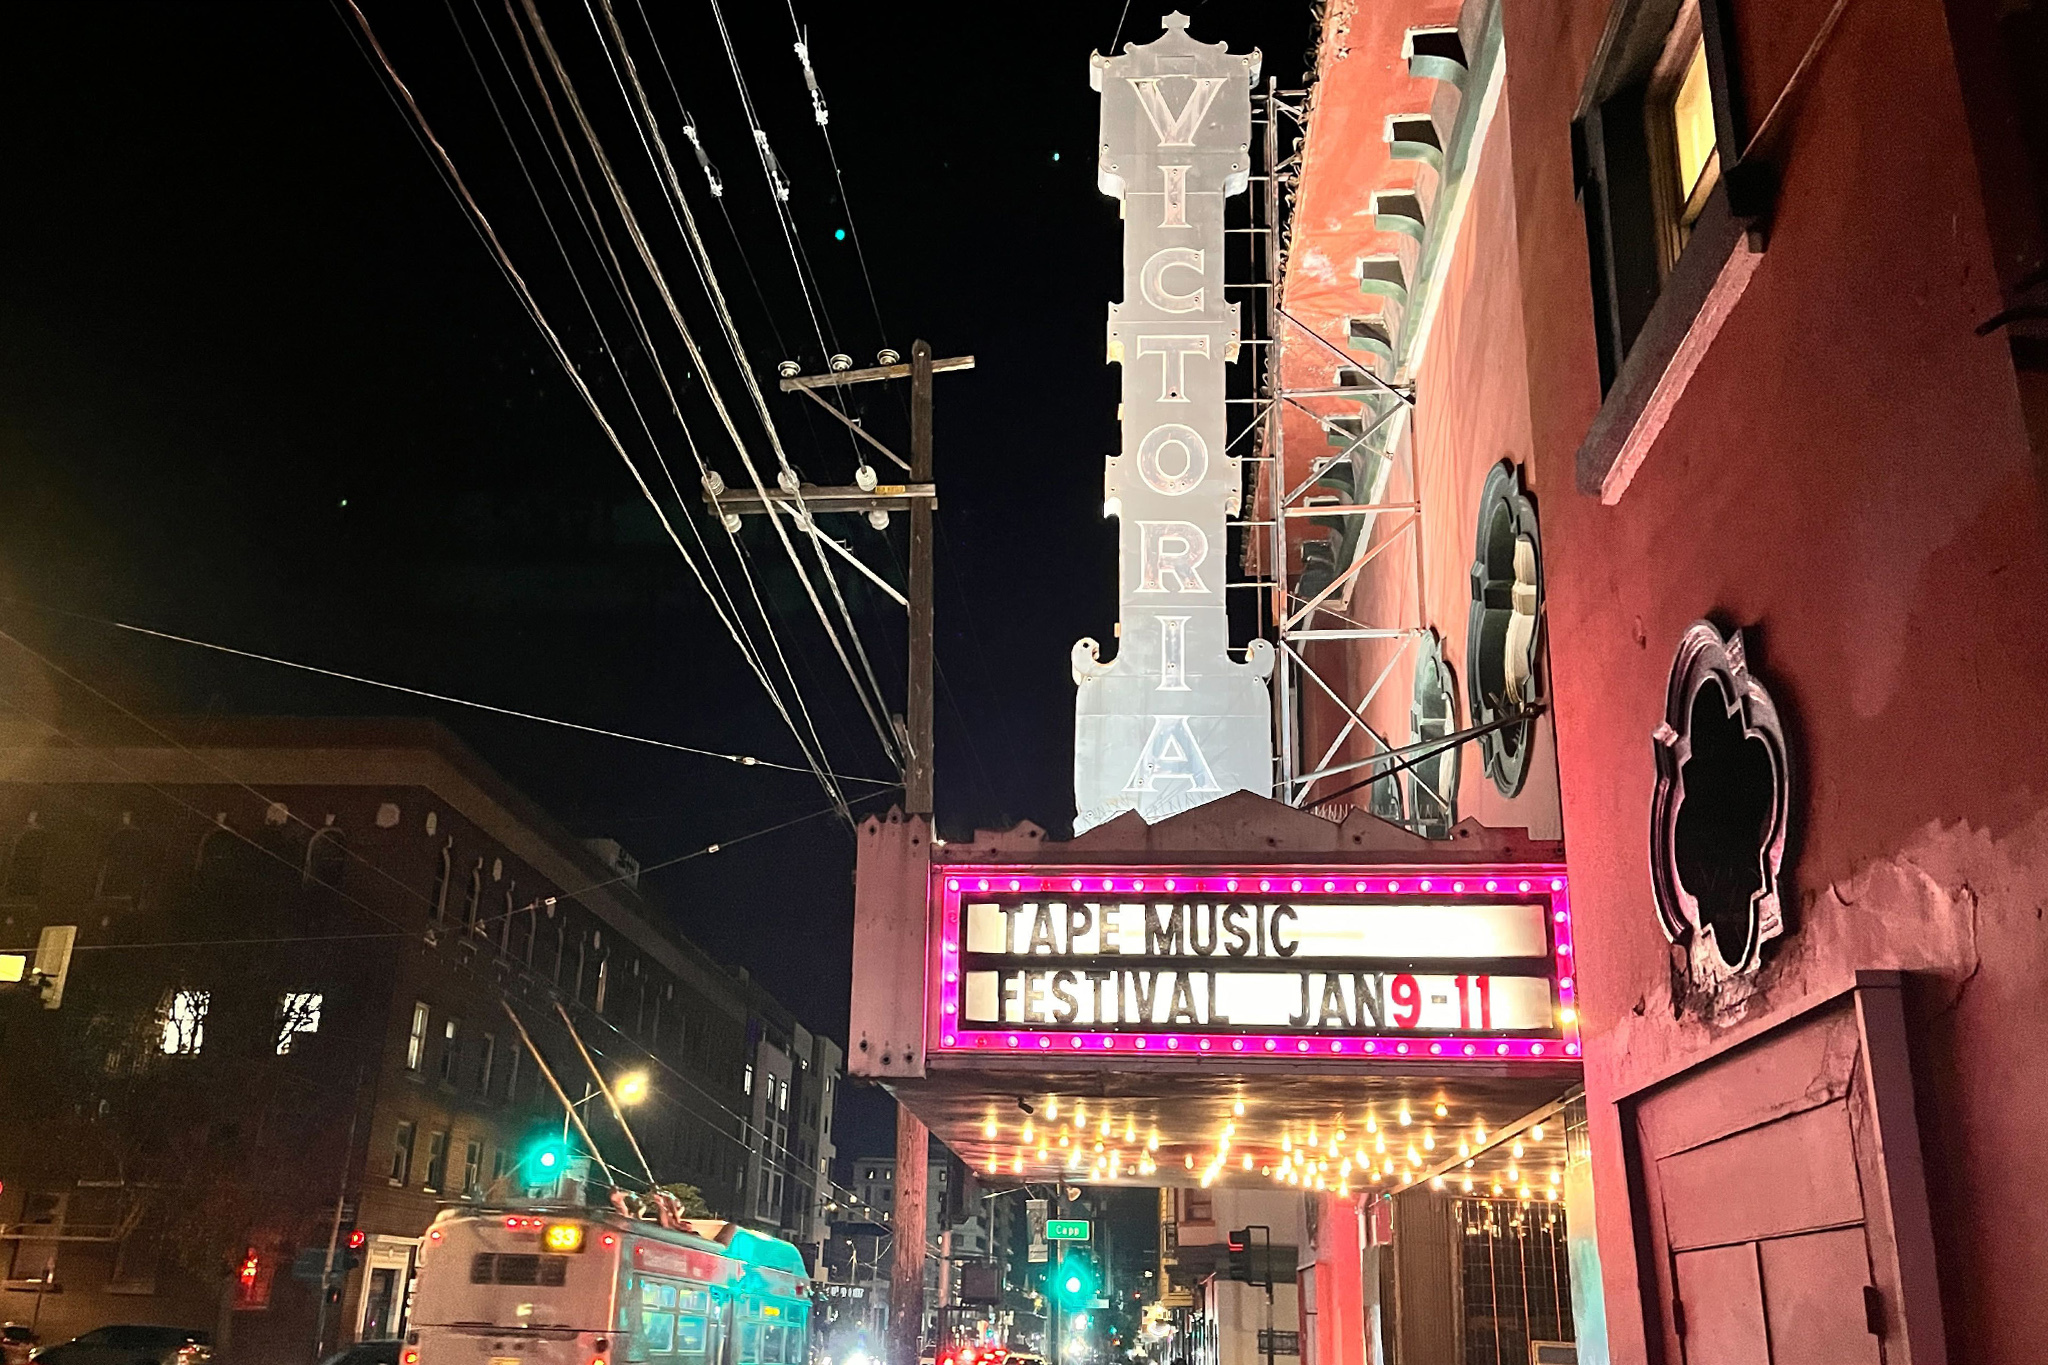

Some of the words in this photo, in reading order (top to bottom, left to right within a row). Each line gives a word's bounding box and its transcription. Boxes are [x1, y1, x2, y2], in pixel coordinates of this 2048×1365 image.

[1121, 77, 1228, 792] VICTORIA
[997, 900, 1121, 956] TAPE
[1144, 902, 1300, 958] MUSIC
[998, 968, 1231, 1025] FESTIVAL
[551, 1228, 576, 1246] 33
[1055, 1224, 1080, 1237] Capp
